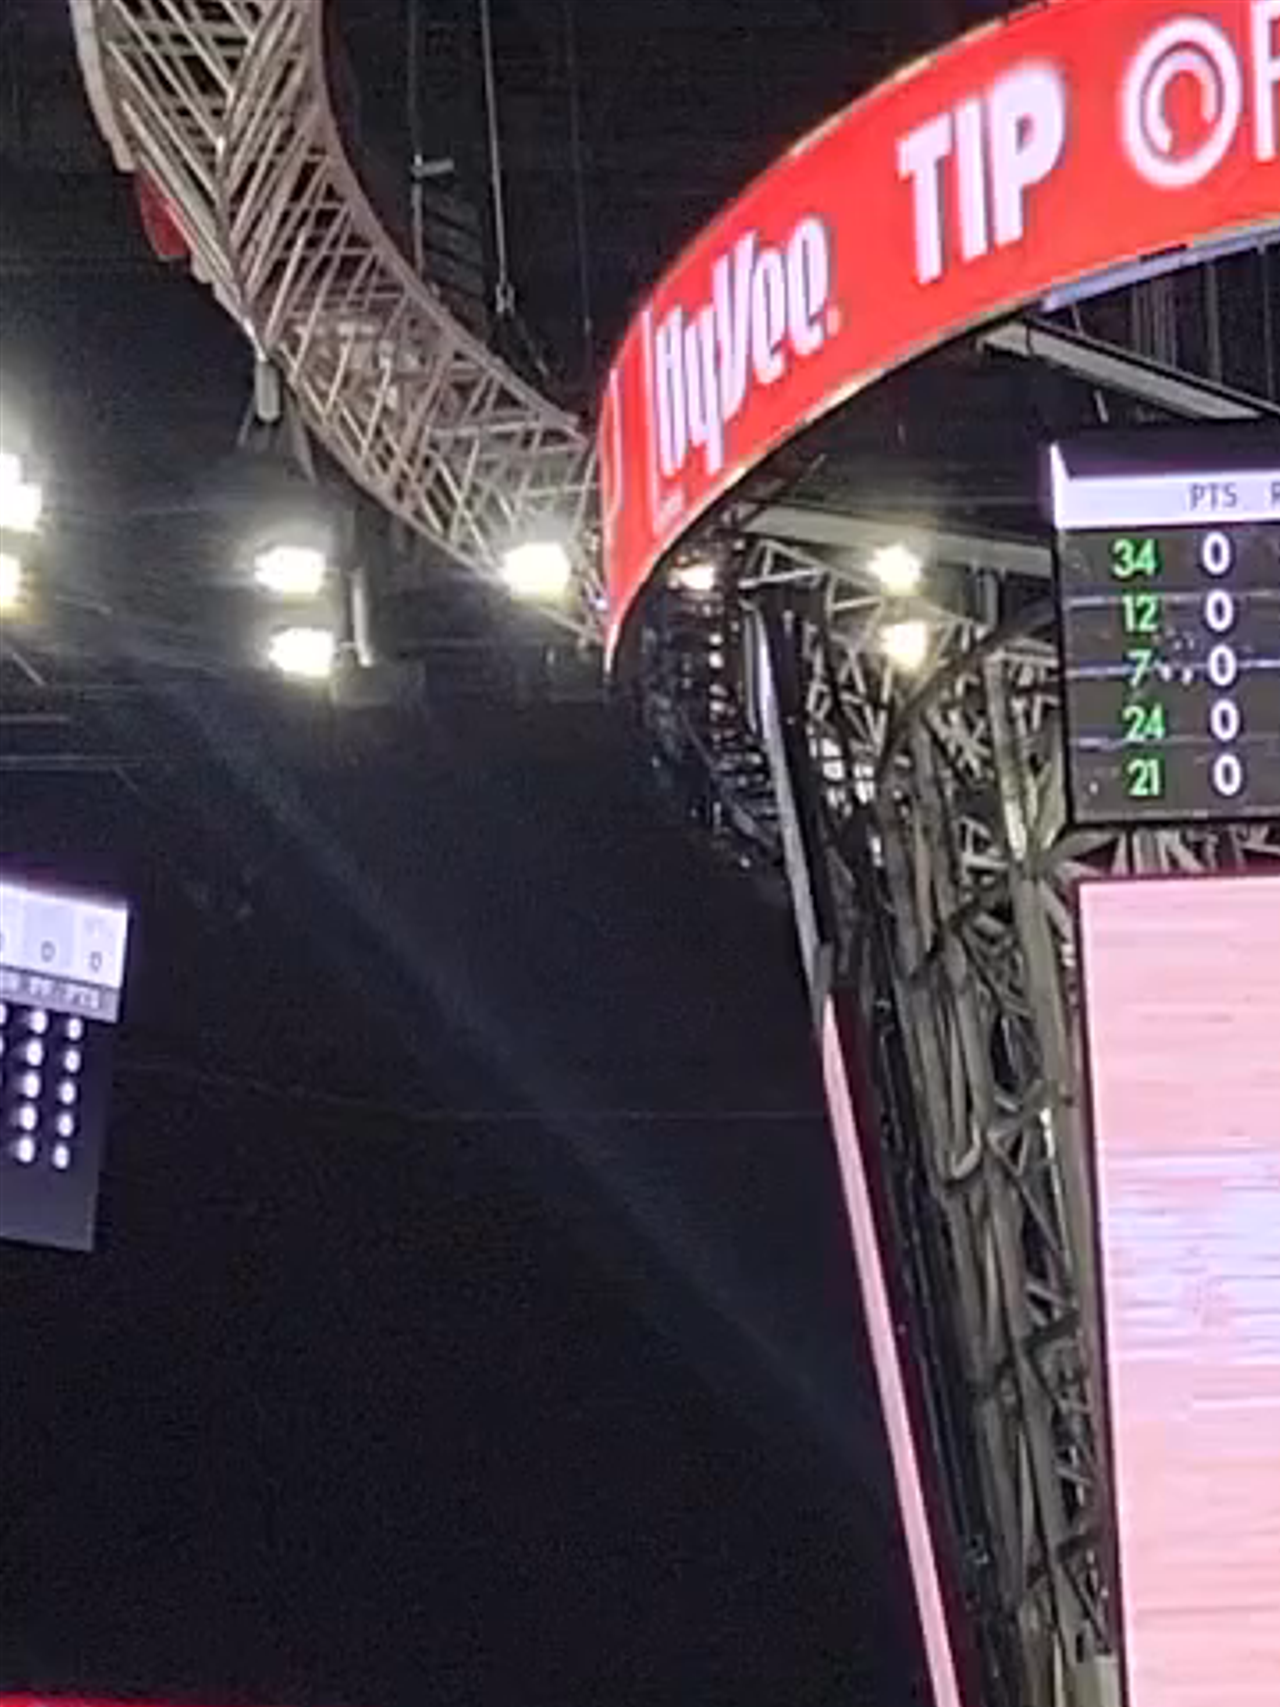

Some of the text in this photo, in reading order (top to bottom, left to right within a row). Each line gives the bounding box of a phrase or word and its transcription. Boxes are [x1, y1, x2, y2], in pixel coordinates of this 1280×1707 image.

[896, 58, 1067, 285] TIP
[1190, 483, 1237, 508] PTS
[1113, 541, 1157, 577] 34
[1203, 533, 1230, 573] 0
[1123, 596, 1157, 633] 12
[1205, 590, 1233, 632] 0
[1128, 651, 1155, 686] 7
[1208, 645, 1236, 686] 0
[1123, 706, 1164, 741] 24
[1211, 700, 1239, 741] 0
[1129, 760, 1161, 796] 21
[1213, 755, 1242, 795] 0
